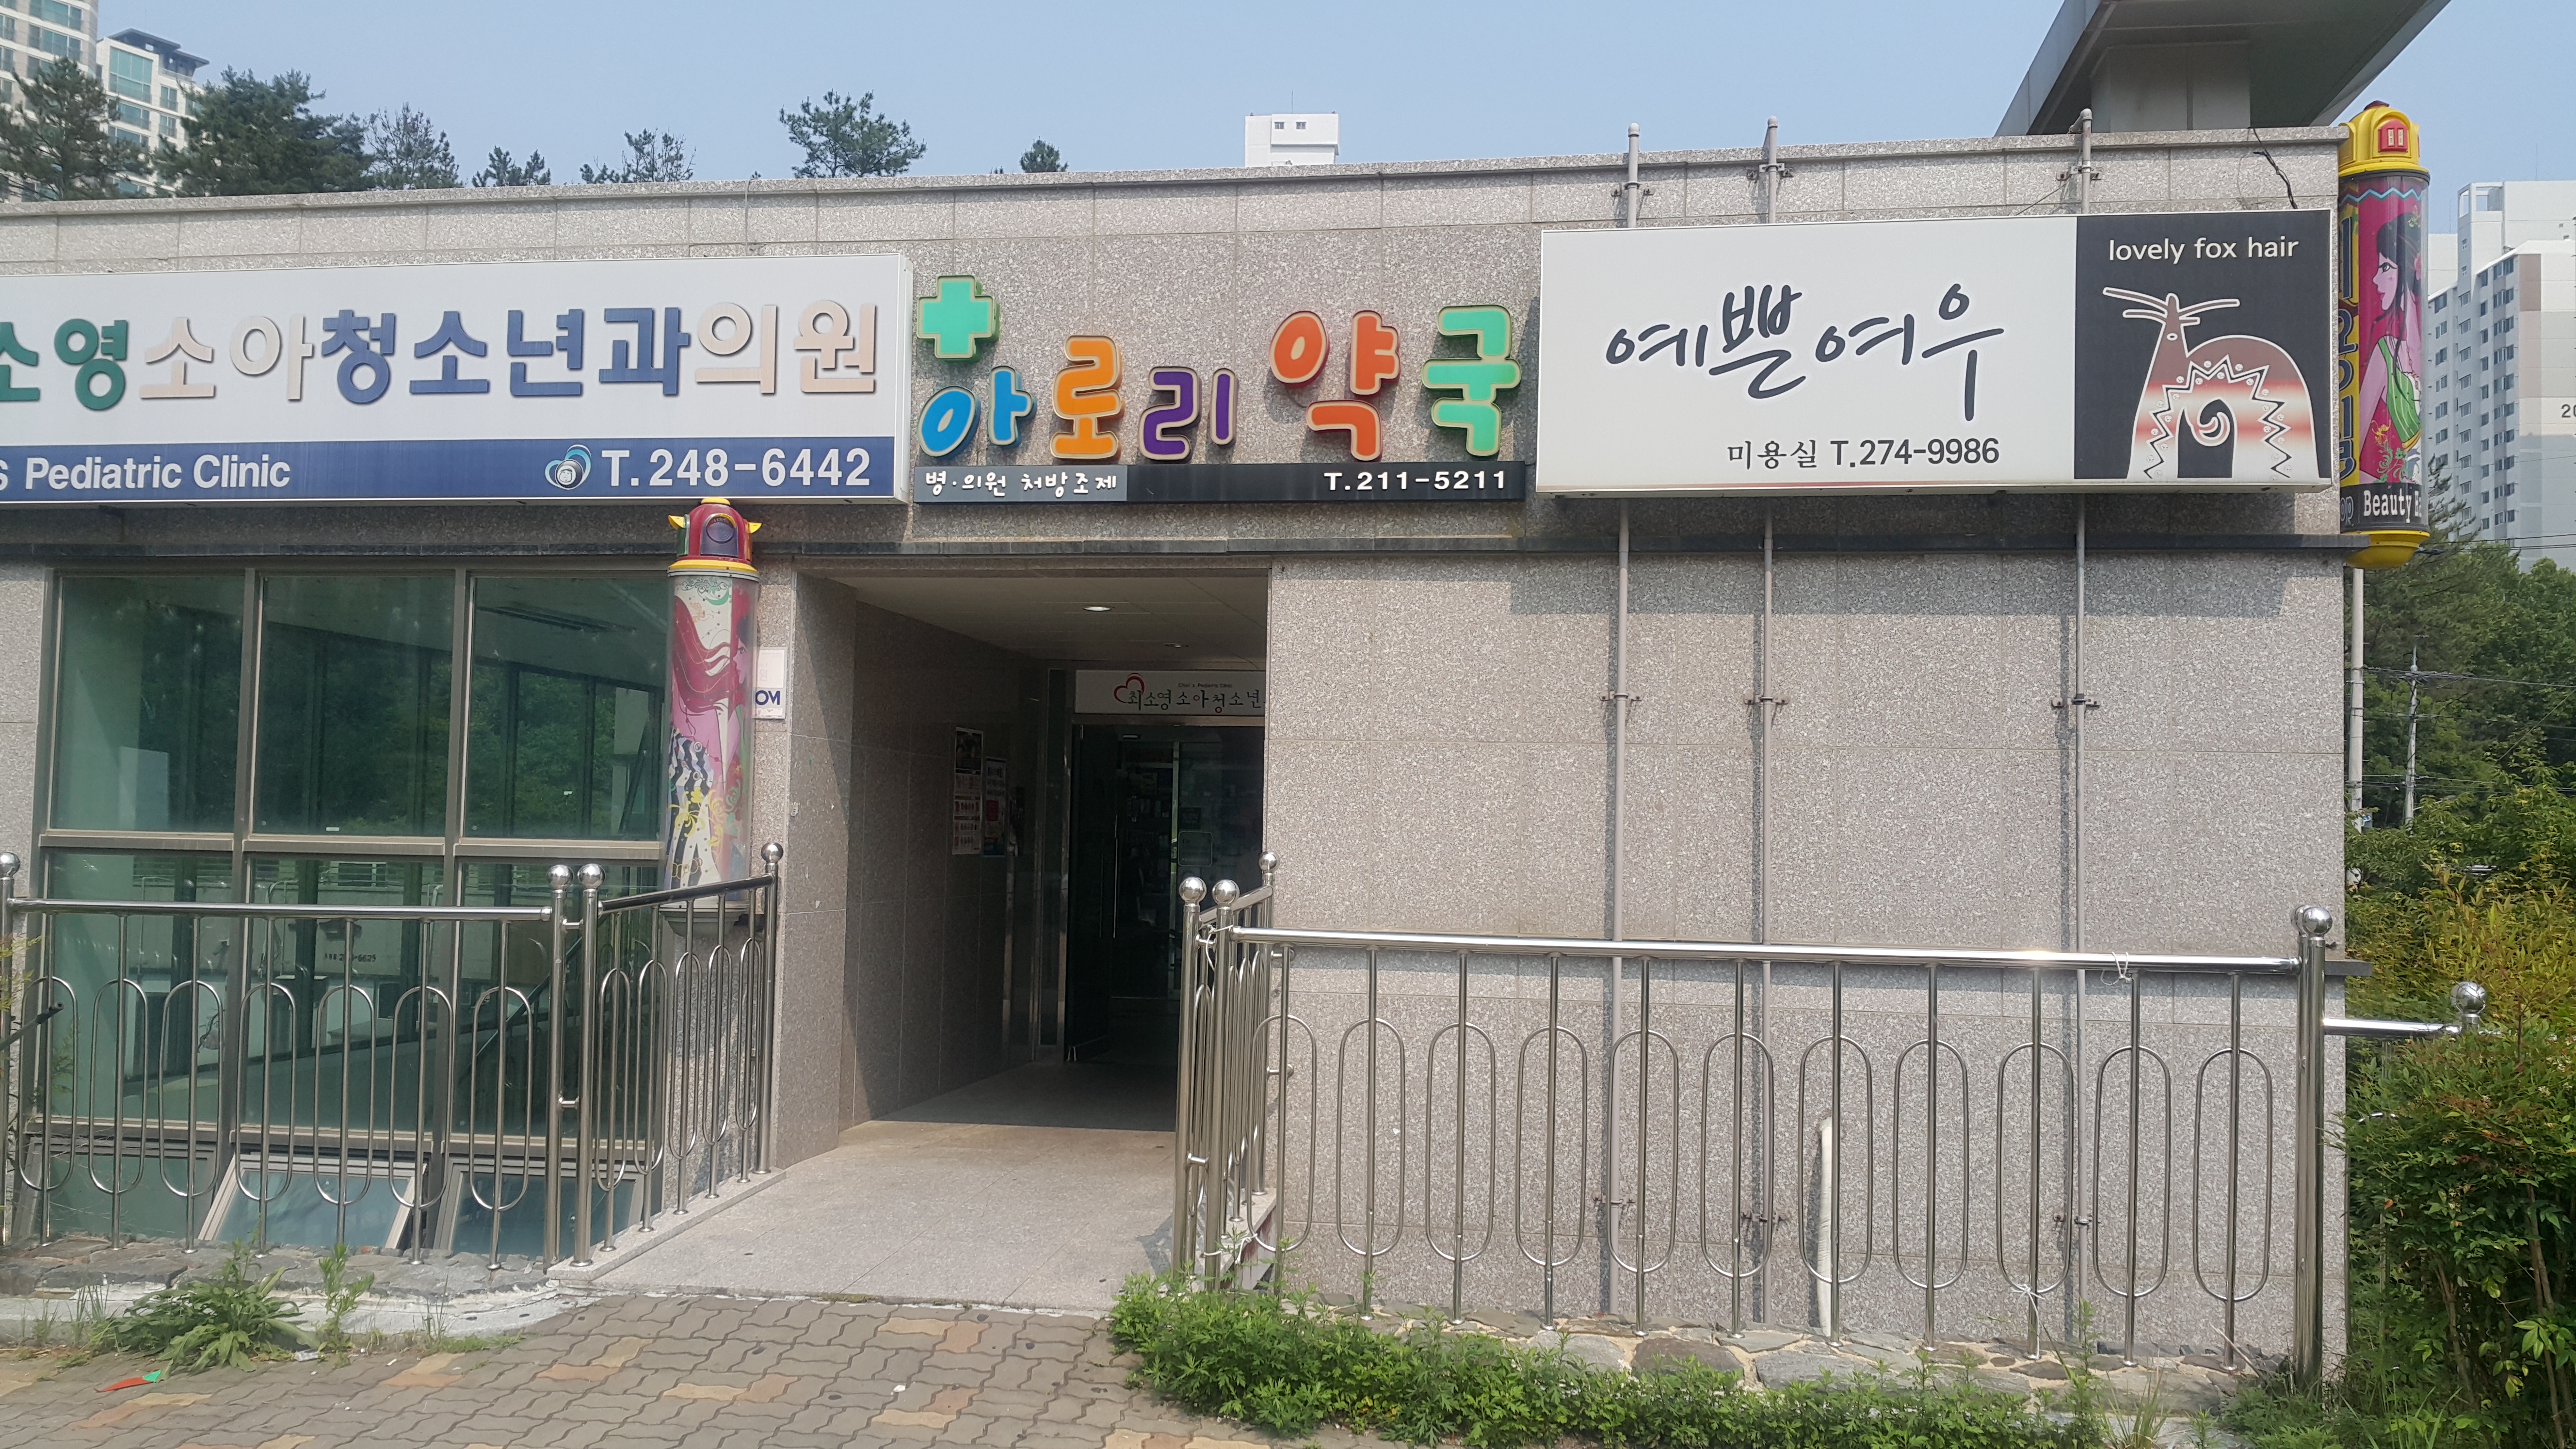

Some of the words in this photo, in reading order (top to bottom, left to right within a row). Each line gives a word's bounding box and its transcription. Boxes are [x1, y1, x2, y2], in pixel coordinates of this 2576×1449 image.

[2109, 238, 2186, 265] lovely
[2194, 237, 2238, 258] fox
[2248, 235, 2299, 258] hair
[1269, 305, 1522, 461] 약국
[25, 456, 181, 490] Pediatric
[193, 454, 290, 488] Clinic
[601, 448, 871, 487] T.248-6442
[1727, 439, 1818, 469] 미용실
[1830, 437, 1999, 468] T.274-9986
[1323, 470, 1504, 491] T.211-5211
[2363, 488, 2412, 523] Beauty
